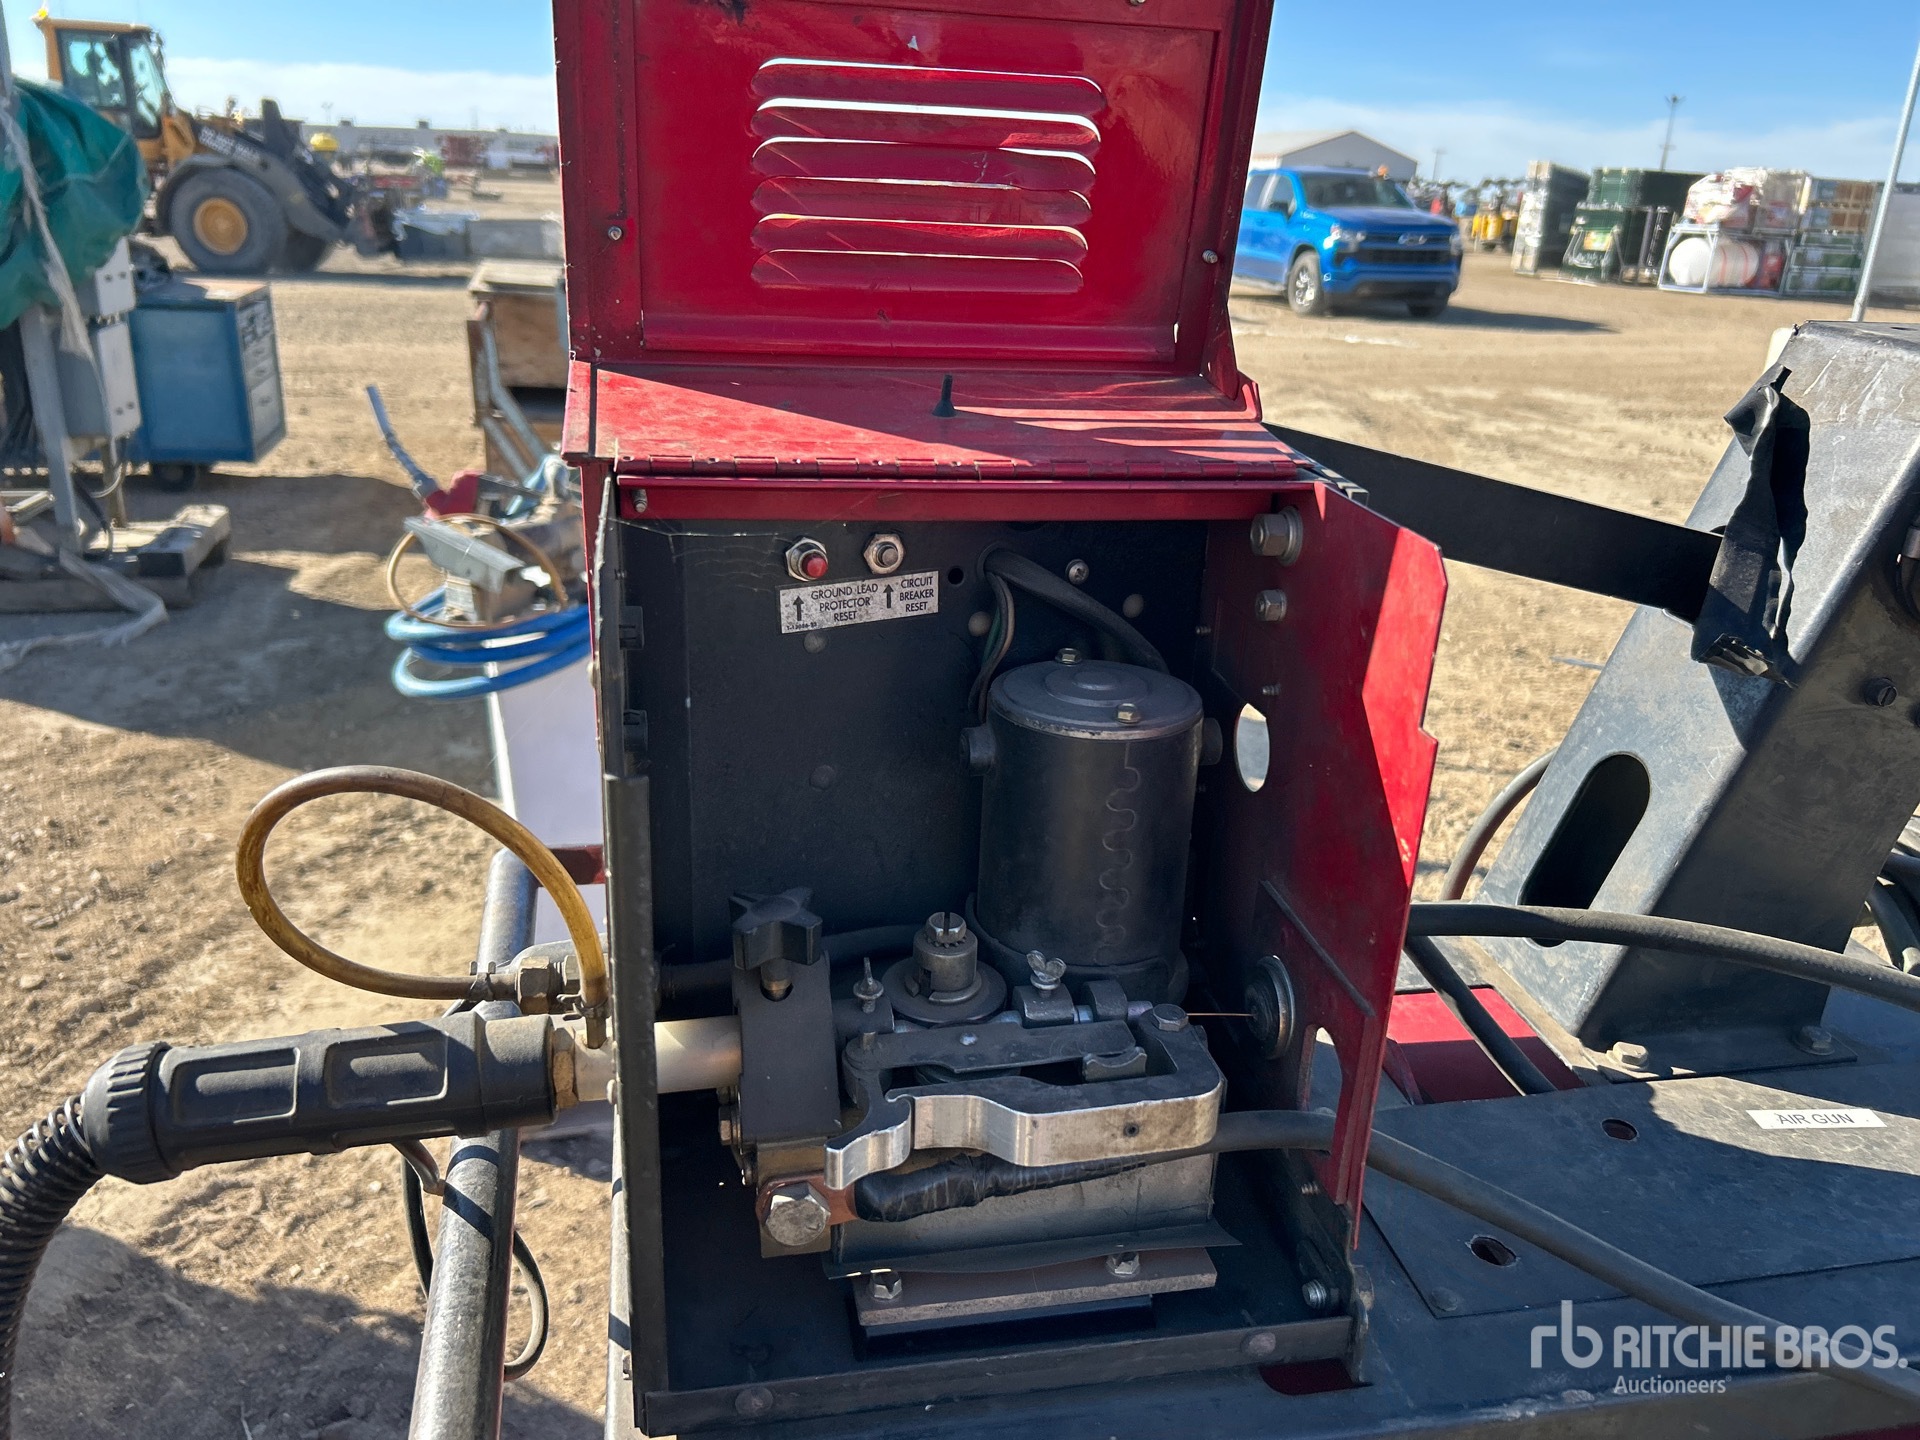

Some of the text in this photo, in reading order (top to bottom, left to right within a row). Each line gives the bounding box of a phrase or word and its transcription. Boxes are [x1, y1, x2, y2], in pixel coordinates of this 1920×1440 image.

[901, 577, 934, 589] CIRCUIT
[811, 584, 879, 600] GROUND LEAD
[900, 589, 934, 601] BREAKER
[819, 598, 872, 612] PROTECTOR
[906, 602, 929, 613] RESET
[834, 611, 857, 622] RESET
[1778, 1113, 1854, 1125] AIR GUN
